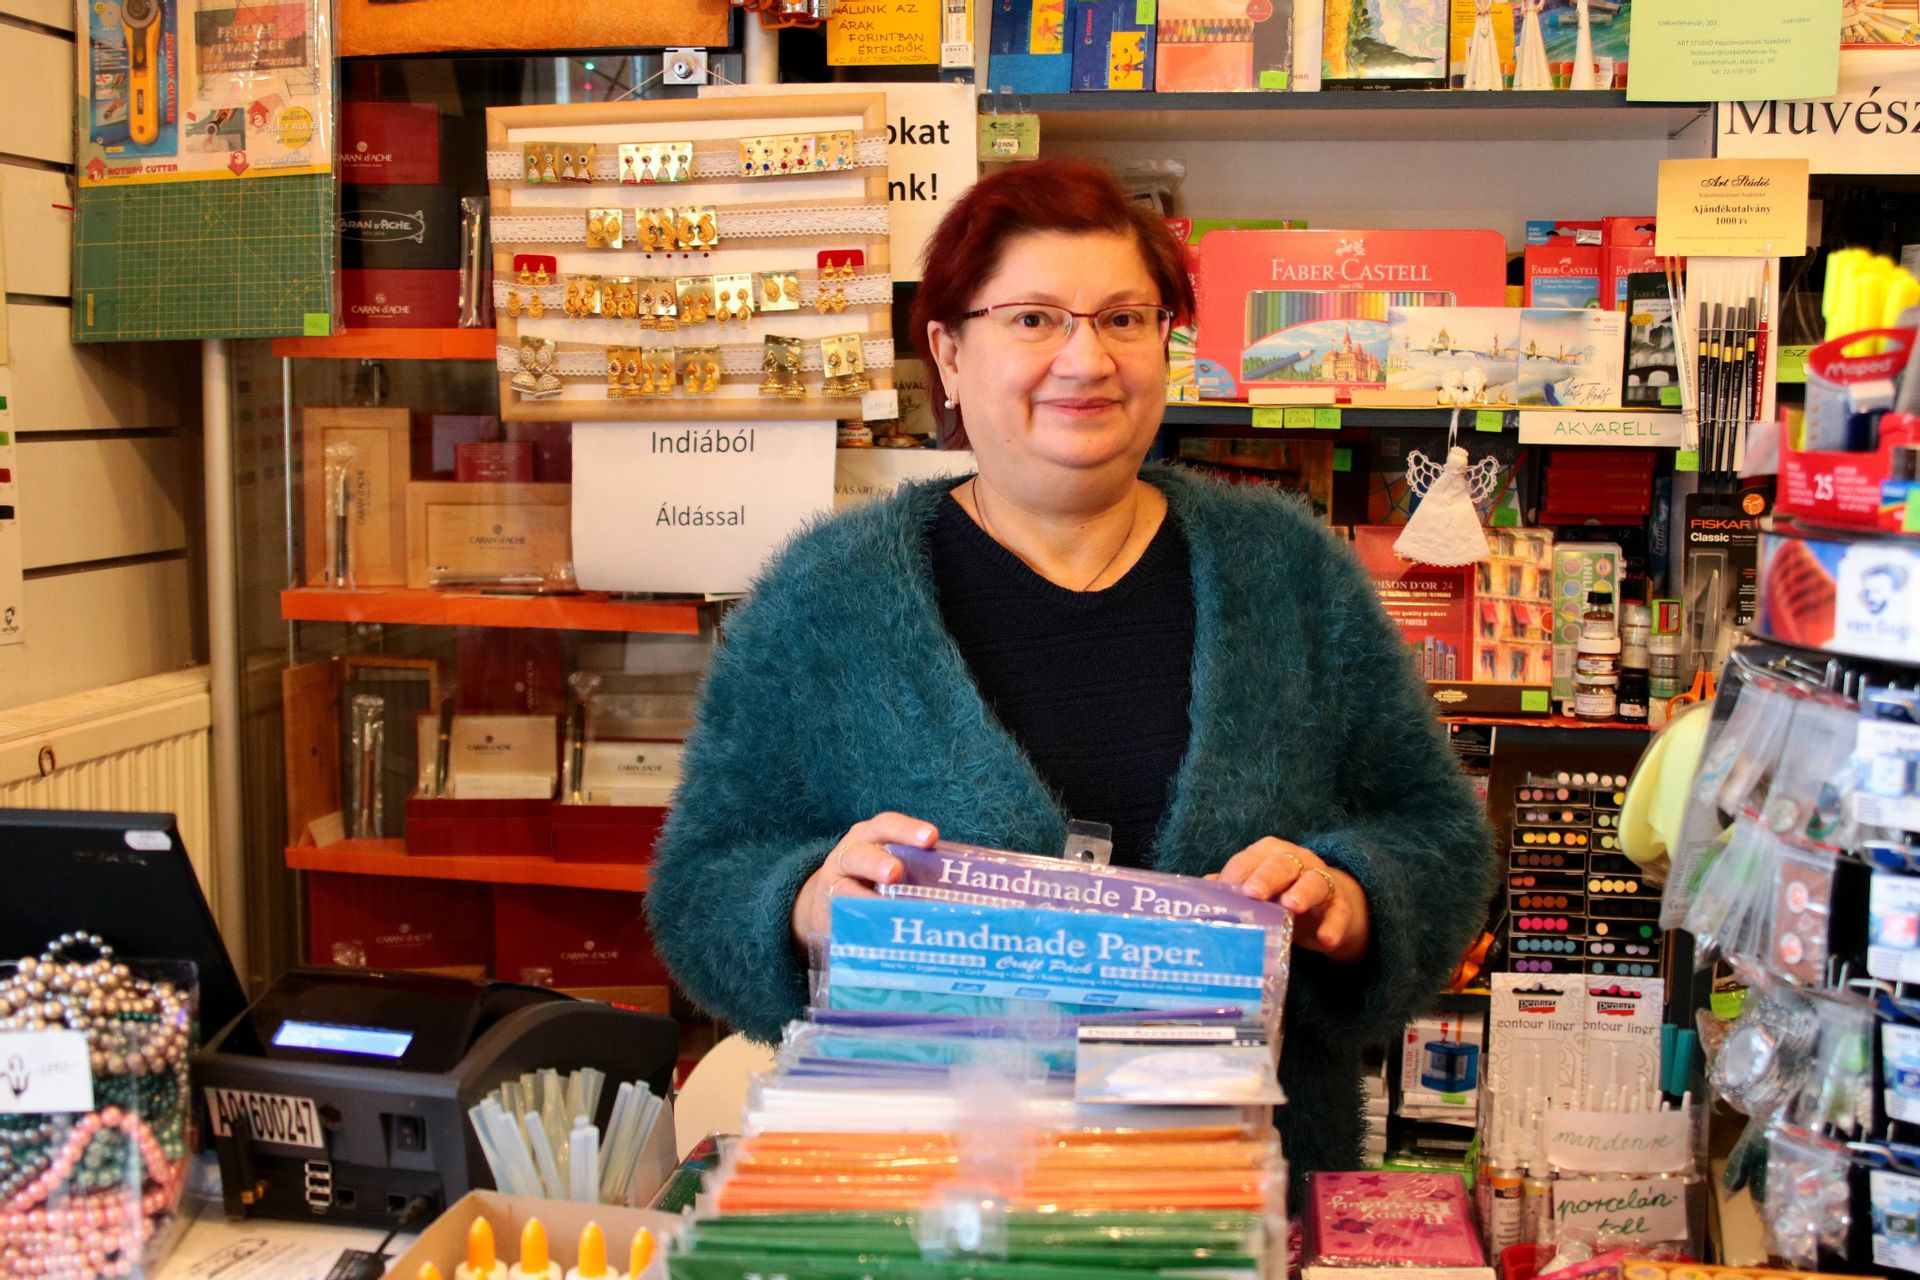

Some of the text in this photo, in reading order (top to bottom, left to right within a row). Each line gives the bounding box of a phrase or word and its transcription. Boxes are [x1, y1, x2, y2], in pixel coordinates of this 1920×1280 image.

[896, 4, 919, 13] AZ
[839, 20, 875, 31] ÁRAK
[848, 33, 925, 42] FORINTBAN
[107, 164, 178, 176] ROTARY CUTTER
[1701, 174, 1771, 188] Art Stúdió
[1692, 204, 1772, 214] Ajándékutalvány
[1716, 217, 1748, 225] 1000 Ft
[1270, 258, 1432, 282] FABER-CASTELL
[1531, 265, 1599, 276] FABER-CASTELL
[351, 304, 410, 314] CARAN d'ACHE
[1824, 359, 1895, 378] Maped
[1554, 421, 1661, 437] AKVARELL
[652, 428, 755, 454] Indiából
[1813, 474, 1834, 501] 25
[655, 501, 745, 527] Áldással
[1690, 532, 1730, 543] Classic
[1410, 580, 1438, 590] D'OR
[1442, 581, 1454, 590] 24
[939, 857, 1121, 908] Handmade
[890, 916, 1086, 959] Handmade
[995, 955, 1093, 975] Craft Pack
[1496, 1019, 1575, 1031] contour liner
[1627, 1023, 1655, 1034] liner
